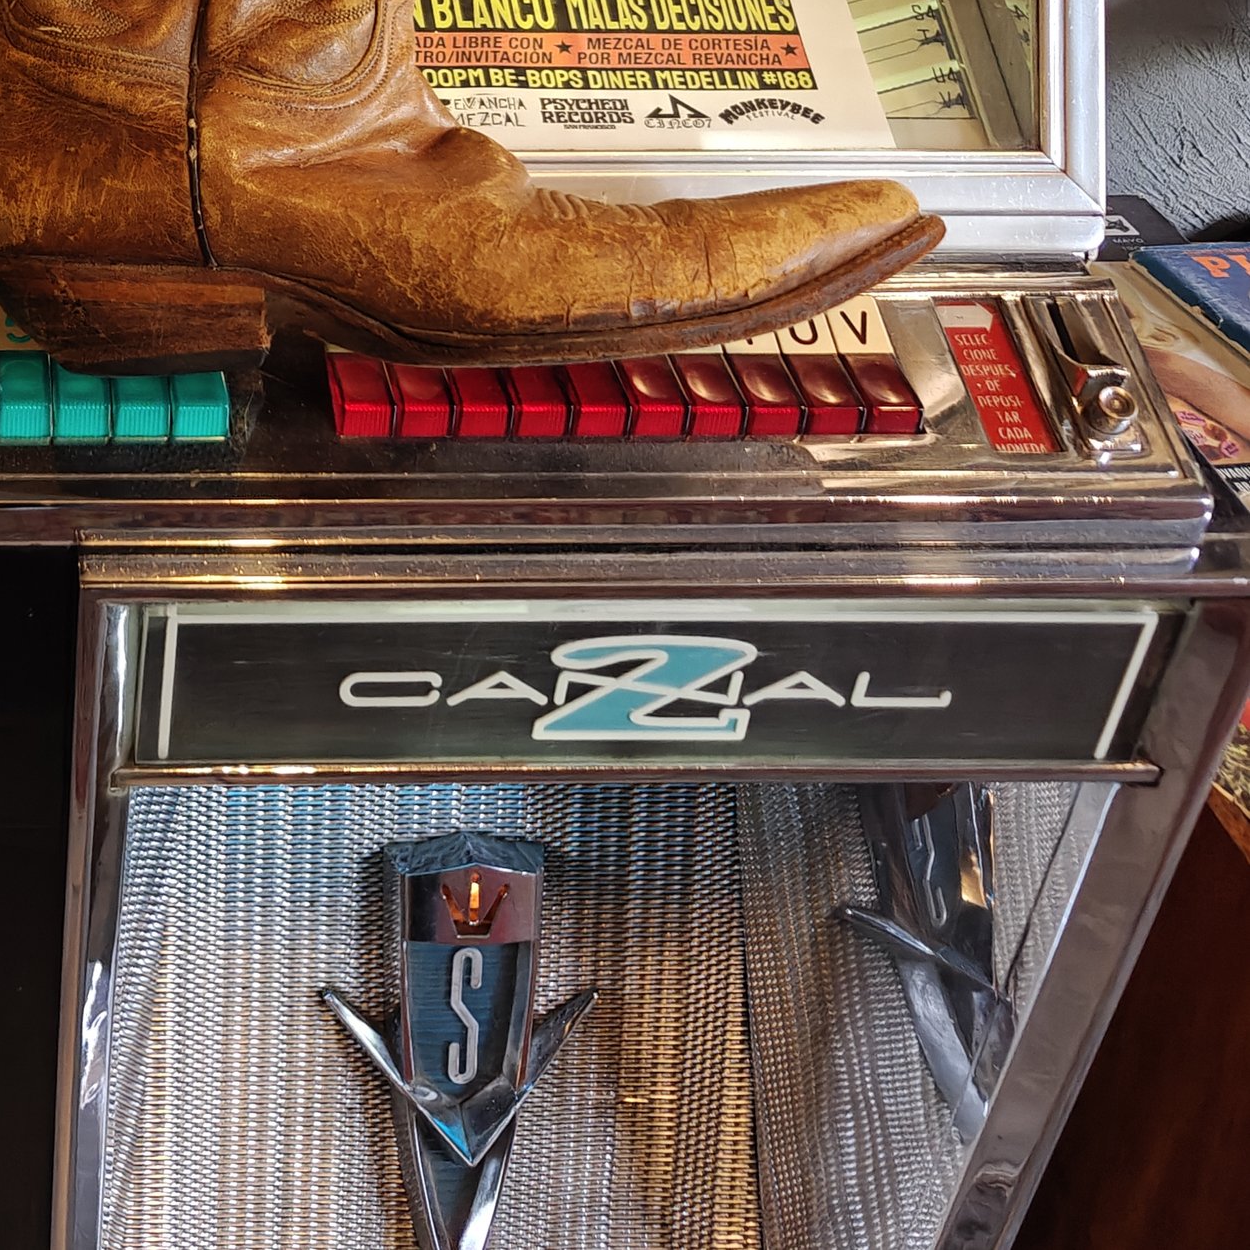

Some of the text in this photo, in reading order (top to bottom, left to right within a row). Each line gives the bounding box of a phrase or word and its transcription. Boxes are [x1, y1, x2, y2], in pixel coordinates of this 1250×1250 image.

[452, 36, 503, 49] LIBRE
[508, 37, 544, 50] CON
[587, 35, 771, 51] MEZCAL DE CORTESÍA
[577, 52, 782, 66] POR MEZCAL REVANCHA
[489, 68, 583, 88] BE-BOPS
[586, 69, 652, 89] DINER
[656, 69, 758, 90] MEDELLIN
[762, 70, 814, 90] #188
[541, 110, 635, 124] RECORDS
[745, 110, 796, 122] FESTIVAL
[839, 310, 868, 345] V
[962, 348, 999, 361] CIONE
[984, 379, 1002, 392] DE
[995, 410, 1022, 424] TAR
[997, 426, 1033, 440] CADA
[339, 669, 952, 708] CANAL
[447, 947, 483, 1085] S
